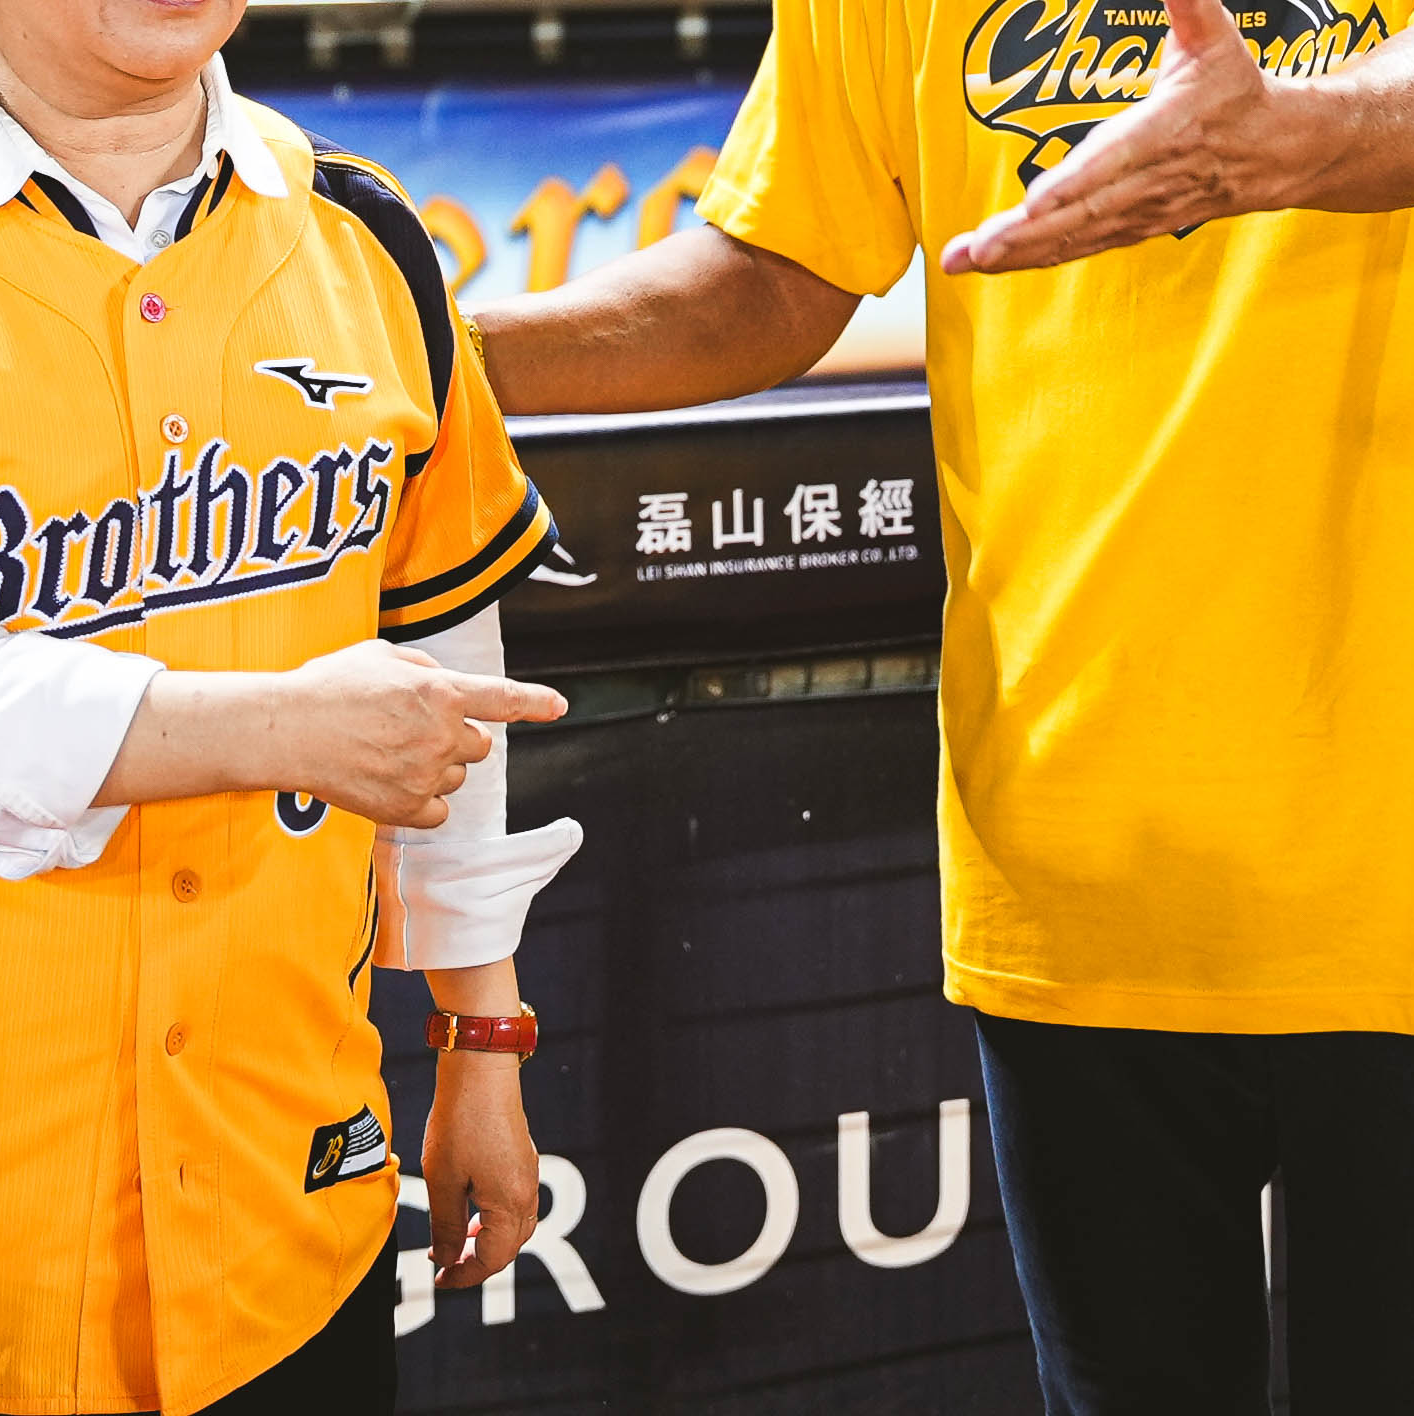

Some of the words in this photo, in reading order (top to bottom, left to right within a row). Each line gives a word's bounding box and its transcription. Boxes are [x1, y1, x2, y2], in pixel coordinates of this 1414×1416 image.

[1104, 9, 1170, 27] TAIWA
[1235, 10, 1267, 29] IES
[635, 478, 916, 554] 磊山保經
[395, 1097, 971, 1337] ROU
